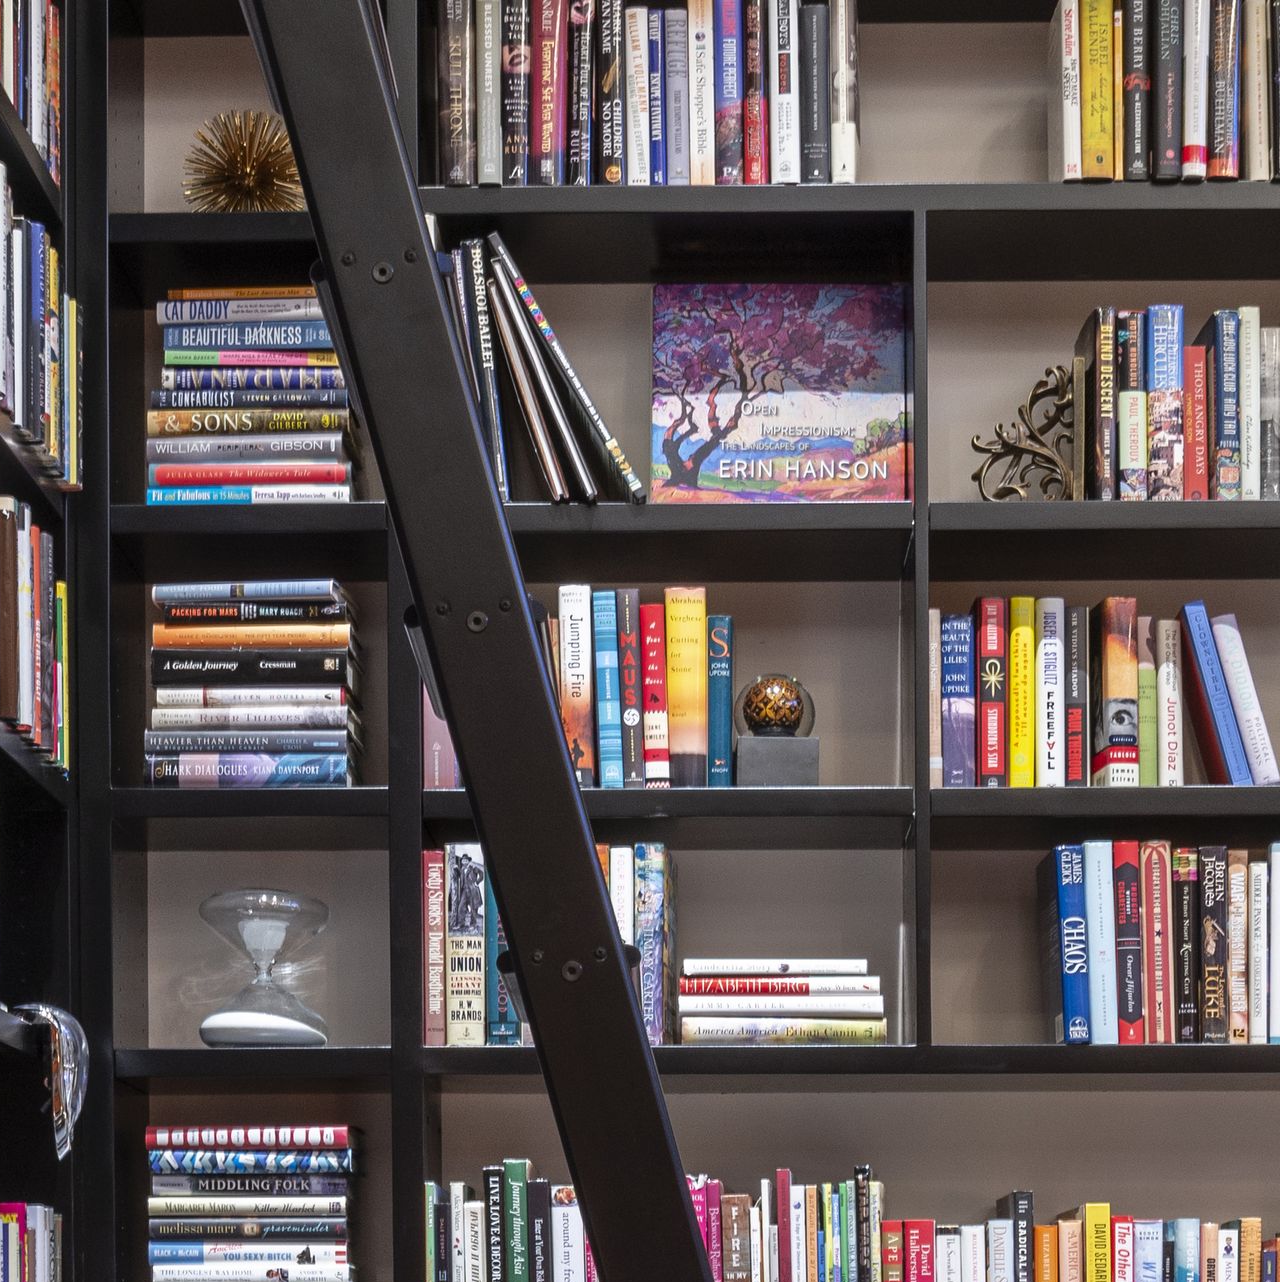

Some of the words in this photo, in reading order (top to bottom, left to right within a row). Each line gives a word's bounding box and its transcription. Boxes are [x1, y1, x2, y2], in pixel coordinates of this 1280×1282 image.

[603, 101, 613, 117] NO
[613, 100, 622, 159] CHILDREN
[603, 119, 613, 157] MORE
[165, 301, 184, 320] CAT
[190, 301, 230, 320] DADDY
[182, 328, 240, 345] BEAUTIFUL
[245, 327, 302, 343] DARKNESS
[1100, 326, 1113, 360] BLIND
[1100, 364, 1113, 419] DESCENT
[172, 392, 234, 407] CONFABULIST
[165, 415, 180, 432] &
[192, 414, 253, 431] SONS
[274, 413, 304, 421] DAVID
[269, 421, 307, 430] GILBERT
[155, 443, 210, 453] WILLIAM
[271, 441, 322, 450] GIBSON
[720, 460, 773, 479] ERIN
[786, 460, 887, 479] HANSON
[204, 608, 217, 616] FOR
[220, 608, 238, 616] MARS
[260, 608, 278, 616] MARY
[280, 608, 304, 616] ROACH
[569, 615, 583, 668] Jumping
[172, 662, 201, 670] Golden
[203, 662, 238, 671] Journey
[260, 661, 296, 669] Cressman
[620, 632, 637, 705] MAUS
[571, 674, 584, 698] Fire
[1064, 916, 1086, 974] CHAOS
[451, 957, 481, 972] UNION
[451, 1010, 482, 1021] BRANDS
[694, 1026, 736, 1037] America
[738, 1026, 778, 1037] America
[784, 1026, 819, 1038] Ethan
[823, 1027, 858, 1038] Canin
[199, 1180, 269, 1190] MIDDLING
[275, 1180, 309, 1190] FOLK
[159, 1224, 203, 1234] melissa
[207, 1225, 237, 1233] marr
[264, 1222, 329, 1237] graveminder
[563, 1212, 571, 1247] around
[1117, 1225, 1128, 1244] The
[888, 1235, 898, 1262] APE
[1018, 1220, 1027, 1266] RADICAL
[223, 1253, 242, 1261] YOU
[244, 1253, 265, 1261] SEXY
[268, 1252, 291, 1261] BITCH
[564, 1252, 571, 1267] my
[1118, 1248, 1129, 1279] Other
